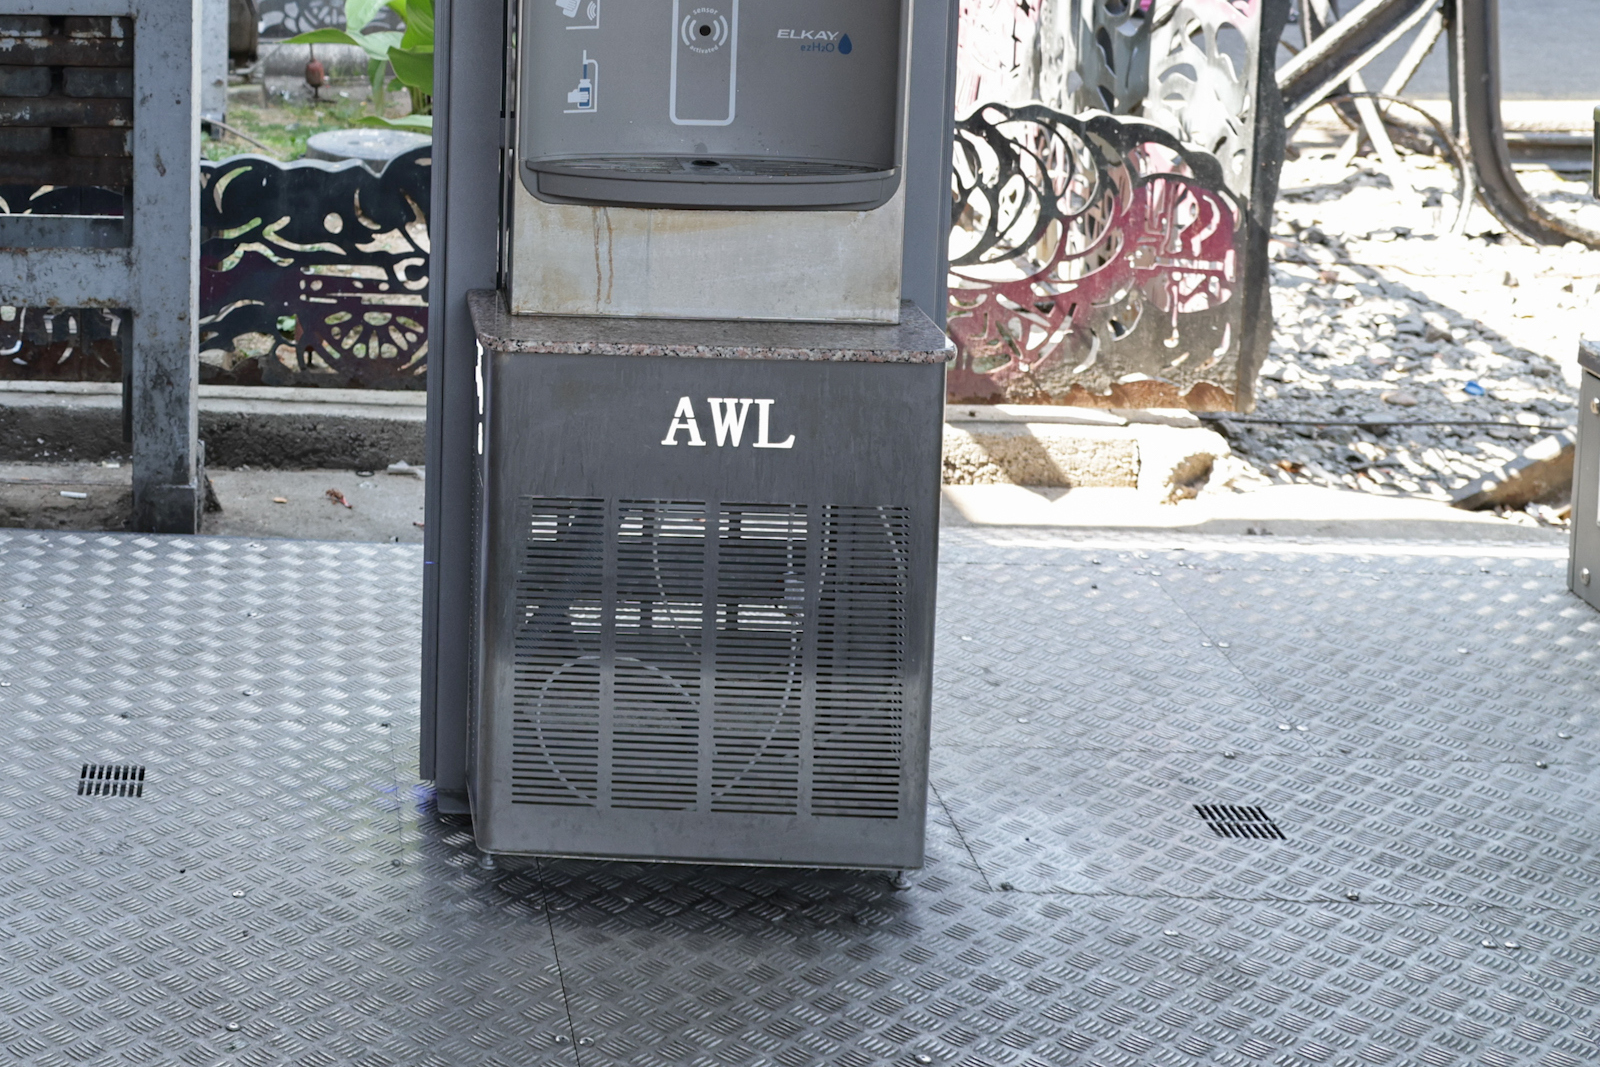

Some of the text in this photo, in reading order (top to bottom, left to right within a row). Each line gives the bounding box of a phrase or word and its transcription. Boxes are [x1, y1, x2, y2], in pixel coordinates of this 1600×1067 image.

[692, 7, 718, 15] sensor
[777, 29, 839, 40] ELKAY
[690, 44, 719, 54] activated
[660, 395, 796, 449] AWL
